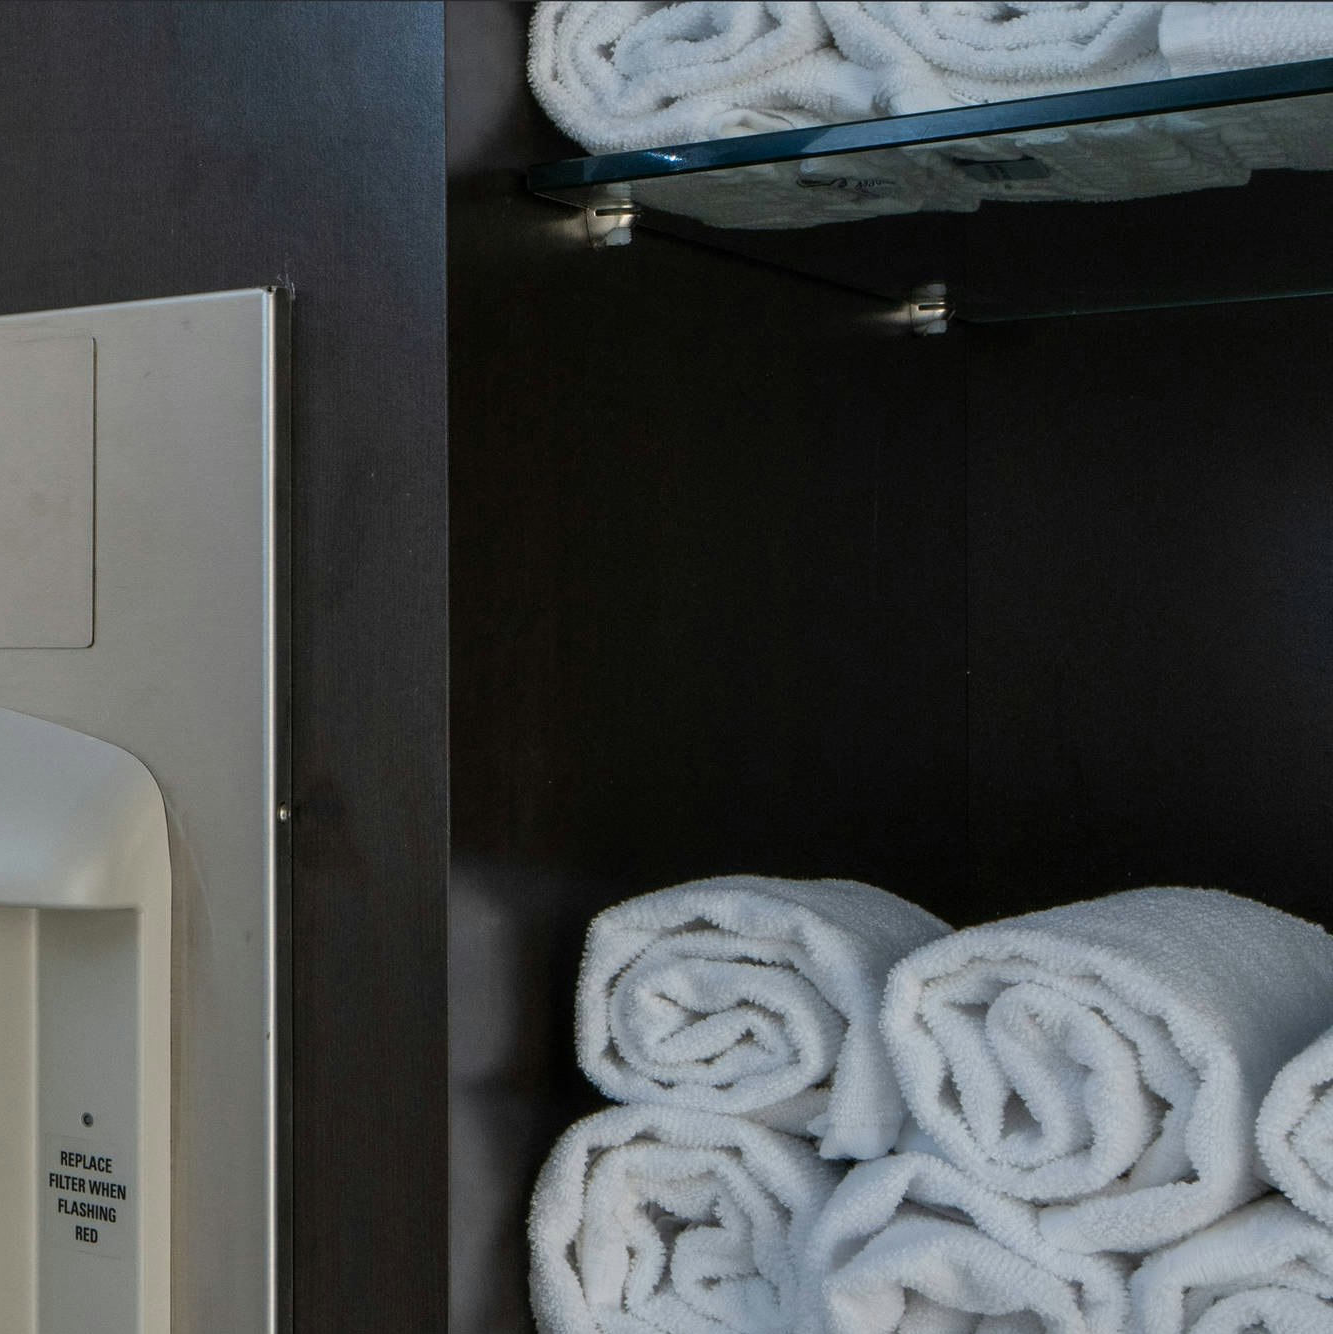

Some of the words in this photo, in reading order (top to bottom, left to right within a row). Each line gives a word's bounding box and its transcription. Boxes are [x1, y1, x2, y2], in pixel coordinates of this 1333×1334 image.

[60, 1150, 113, 1174] REPLACE
[49, 1172, 86, 1194] FILTER
[88, 1179, 127, 1201] WHEN
[57, 1197, 117, 1223] FLASHING
[75, 1225, 99, 1244] RED
